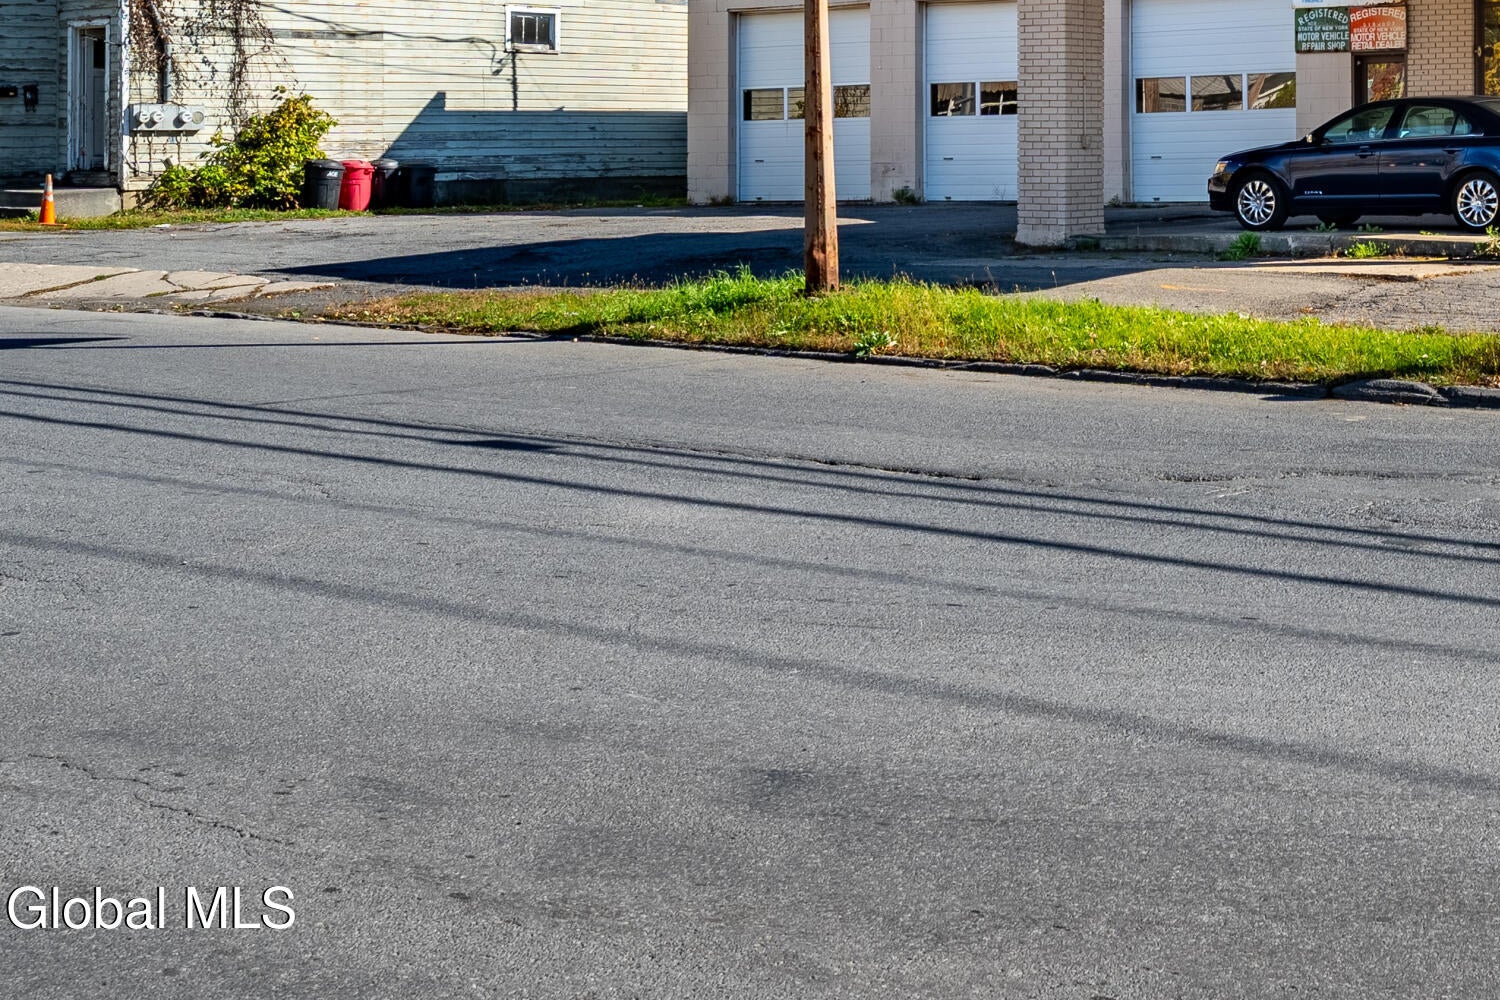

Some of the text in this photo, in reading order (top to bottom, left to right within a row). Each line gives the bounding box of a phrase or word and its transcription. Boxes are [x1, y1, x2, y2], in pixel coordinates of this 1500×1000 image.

[1298, 8, 1349, 26] REGISTERED
[1350, 7, 1406, 23] REGISTERED
[1298, 31, 1349, 41] MOTOR VEHICLE
[1350, 31, 1406, 42] MOTOR VEHICLE
[1301, 41, 1346, 51] REPAIR SHOP
[1351, 40, 1406, 50] RETAIL DEALER
